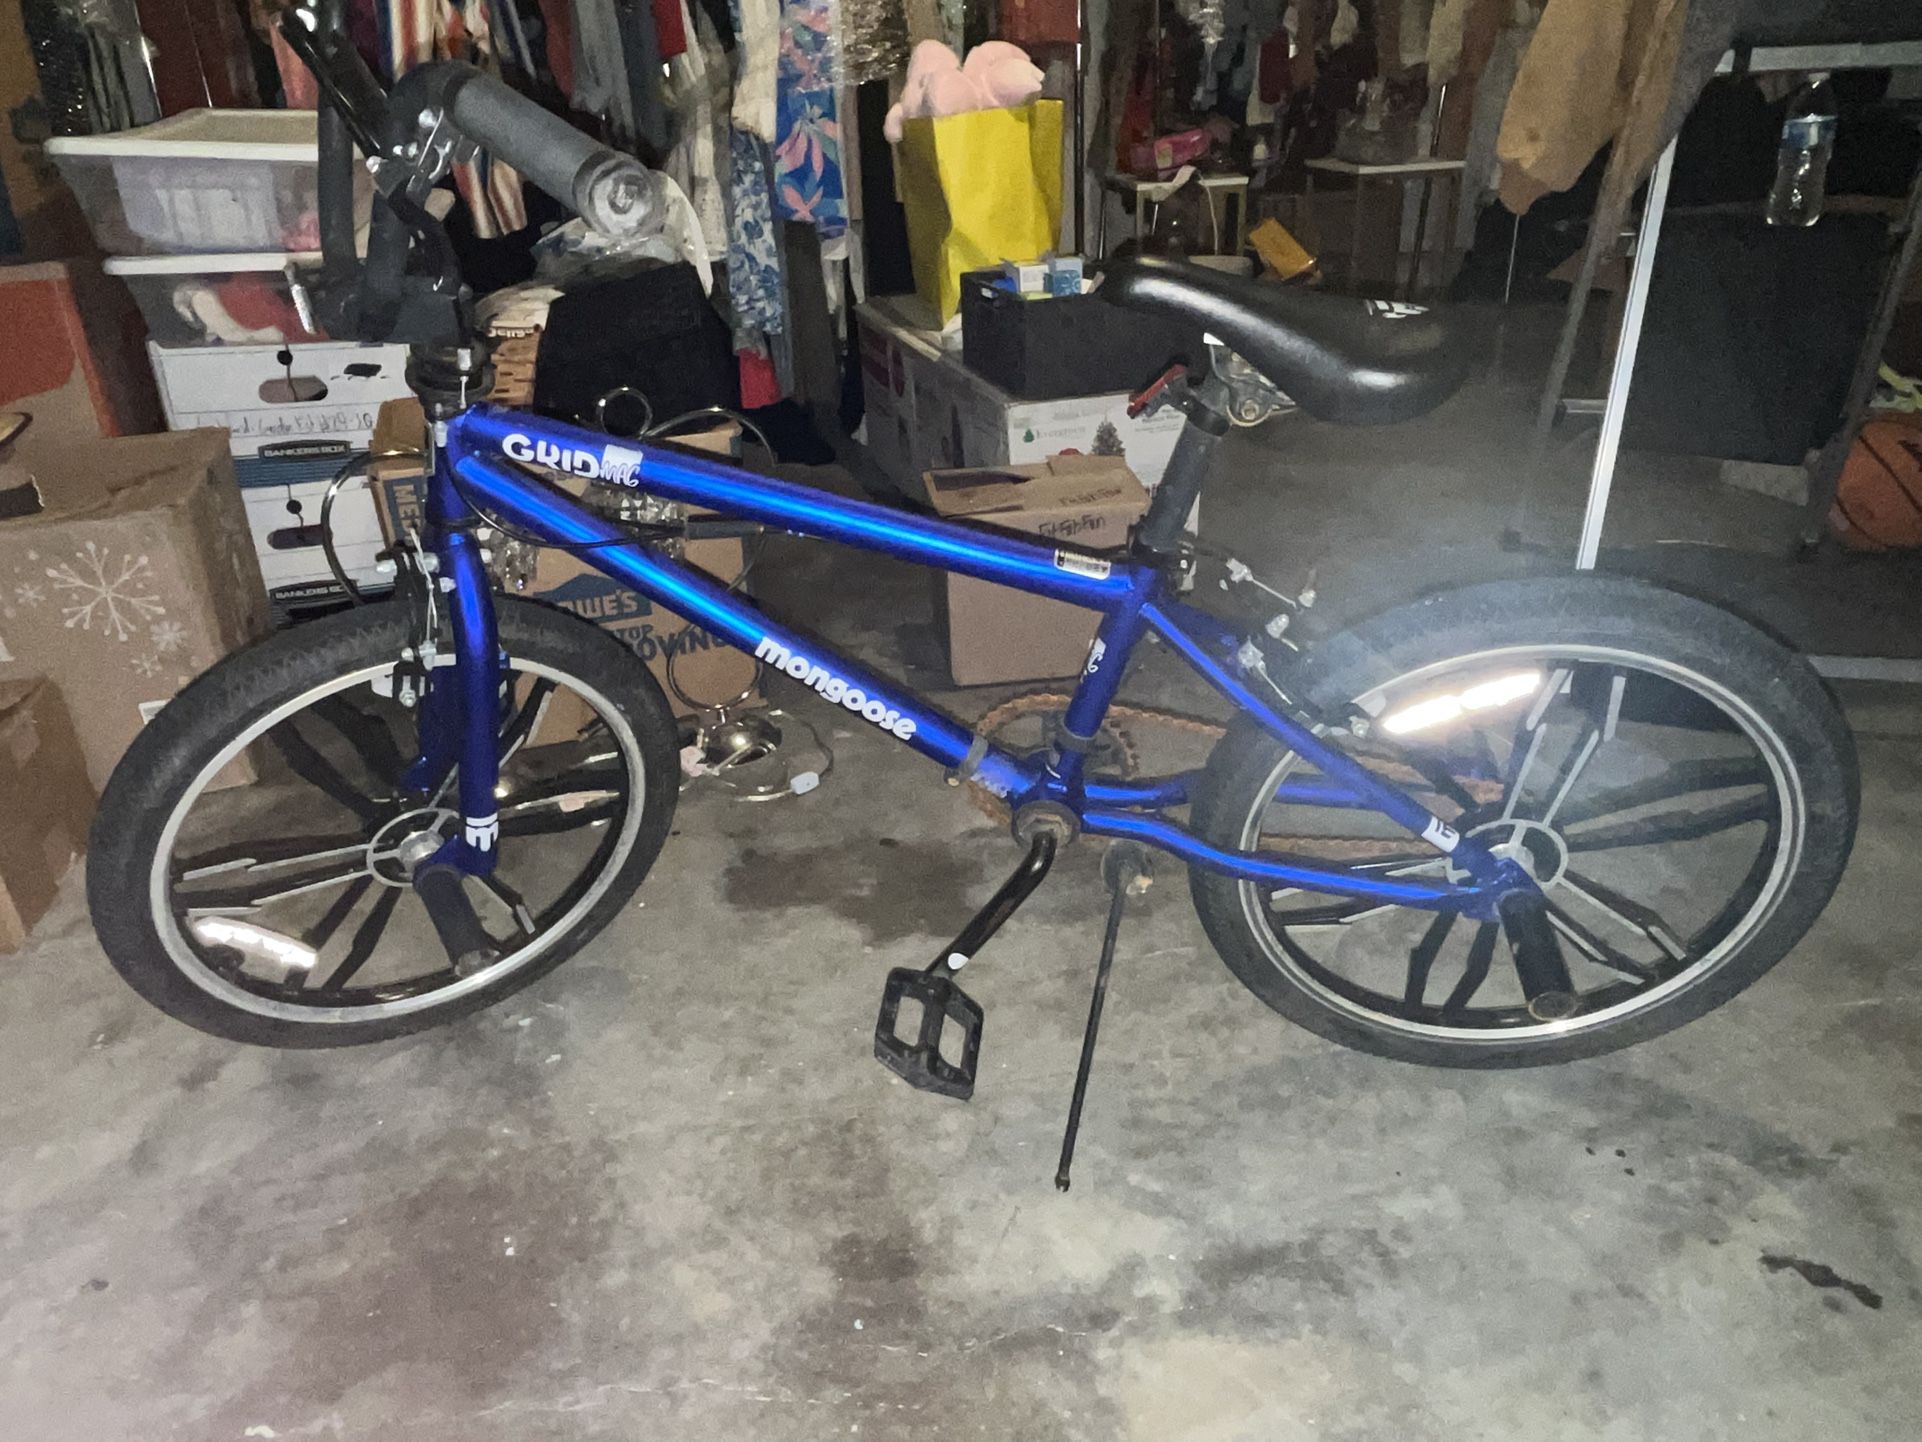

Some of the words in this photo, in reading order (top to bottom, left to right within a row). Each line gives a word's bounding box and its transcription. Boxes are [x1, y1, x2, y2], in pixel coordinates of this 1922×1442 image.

[501, 433, 601, 479] GRID
[600, 460, 641, 488] MAG
[558, 589, 638, 617] WE'S
[613, 624, 654, 642] TOP
[754, 636, 918, 741] mongoose
